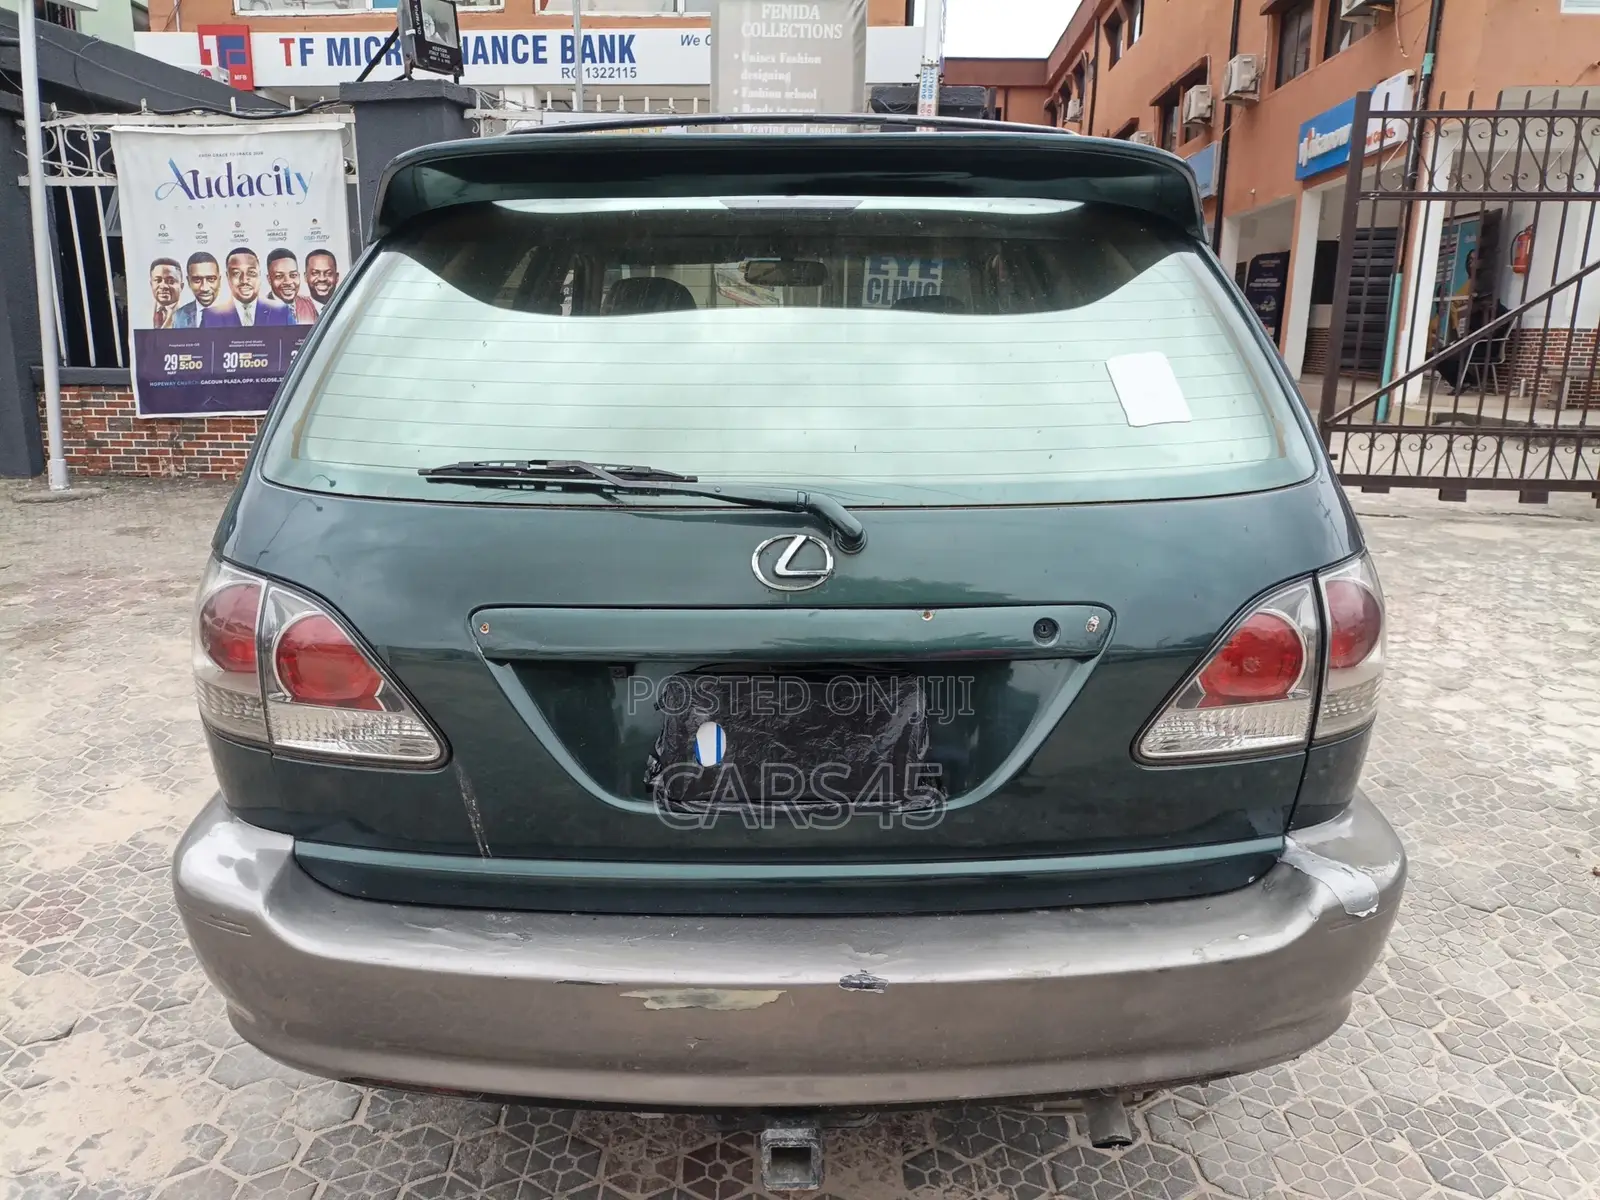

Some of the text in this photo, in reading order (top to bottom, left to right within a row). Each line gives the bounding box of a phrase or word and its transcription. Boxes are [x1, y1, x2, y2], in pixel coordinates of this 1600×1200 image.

[761, 3, 821, 20] FENIDA
[741, 21, 843, 39] COLLECTIONS
[680, 34, 701, 47] We
[279, 37, 314, 67] TF
[560, 34, 636, 64] BANK
[779, 52, 822, 64] Fashion
[585, 66, 637, 79] 1322115
[740, 68, 792, 84] designing
[741, 86, 817, 100] Fashion school
[154, 157, 313, 204] Audacity
[868, 255, 940, 280] EYE
[164, 354, 178, 371] 29
[179, 360, 203, 370] 5:00
[222, 352, 239, 369] 30
[239, 358, 268, 368] 10:00
